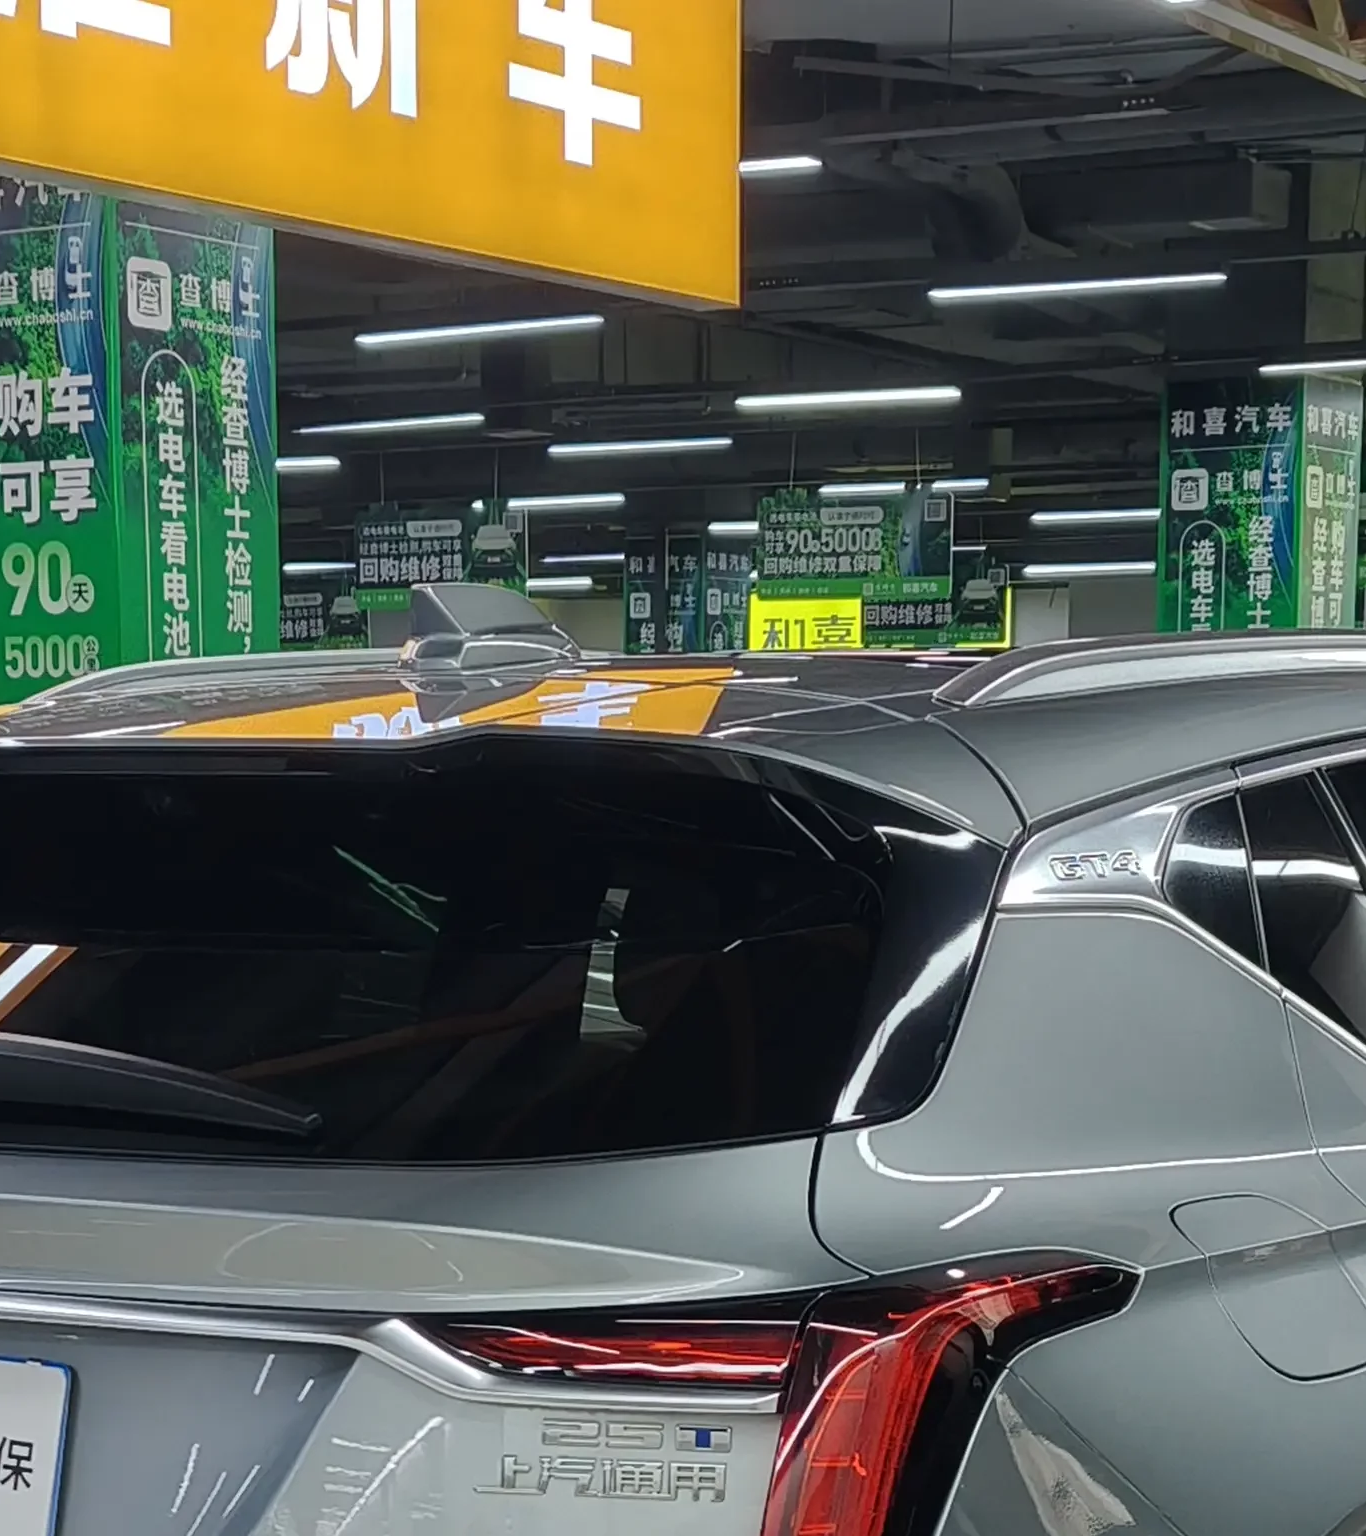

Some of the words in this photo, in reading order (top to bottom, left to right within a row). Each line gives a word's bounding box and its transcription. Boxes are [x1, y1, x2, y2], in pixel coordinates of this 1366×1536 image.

[180, 273, 261, 319] 查博士
[1170, 402, 1292, 438] 和喜汽车
[1306, 404, 1359, 441] 和喜汽车
[154, 380, 192, 657] 选电车看电池
[1, 540, 95, 616] 90天
[359, 557, 442, 584] 回购维修
[1246, 515, 1275, 629] 经查博士
[864, 603, 935, 626] 回购维修
[1047, 850, 1142, 881] GT4
[540, 1416, 734, 1454] 25T
[472, 1453, 728, 1504] 上汽通用
